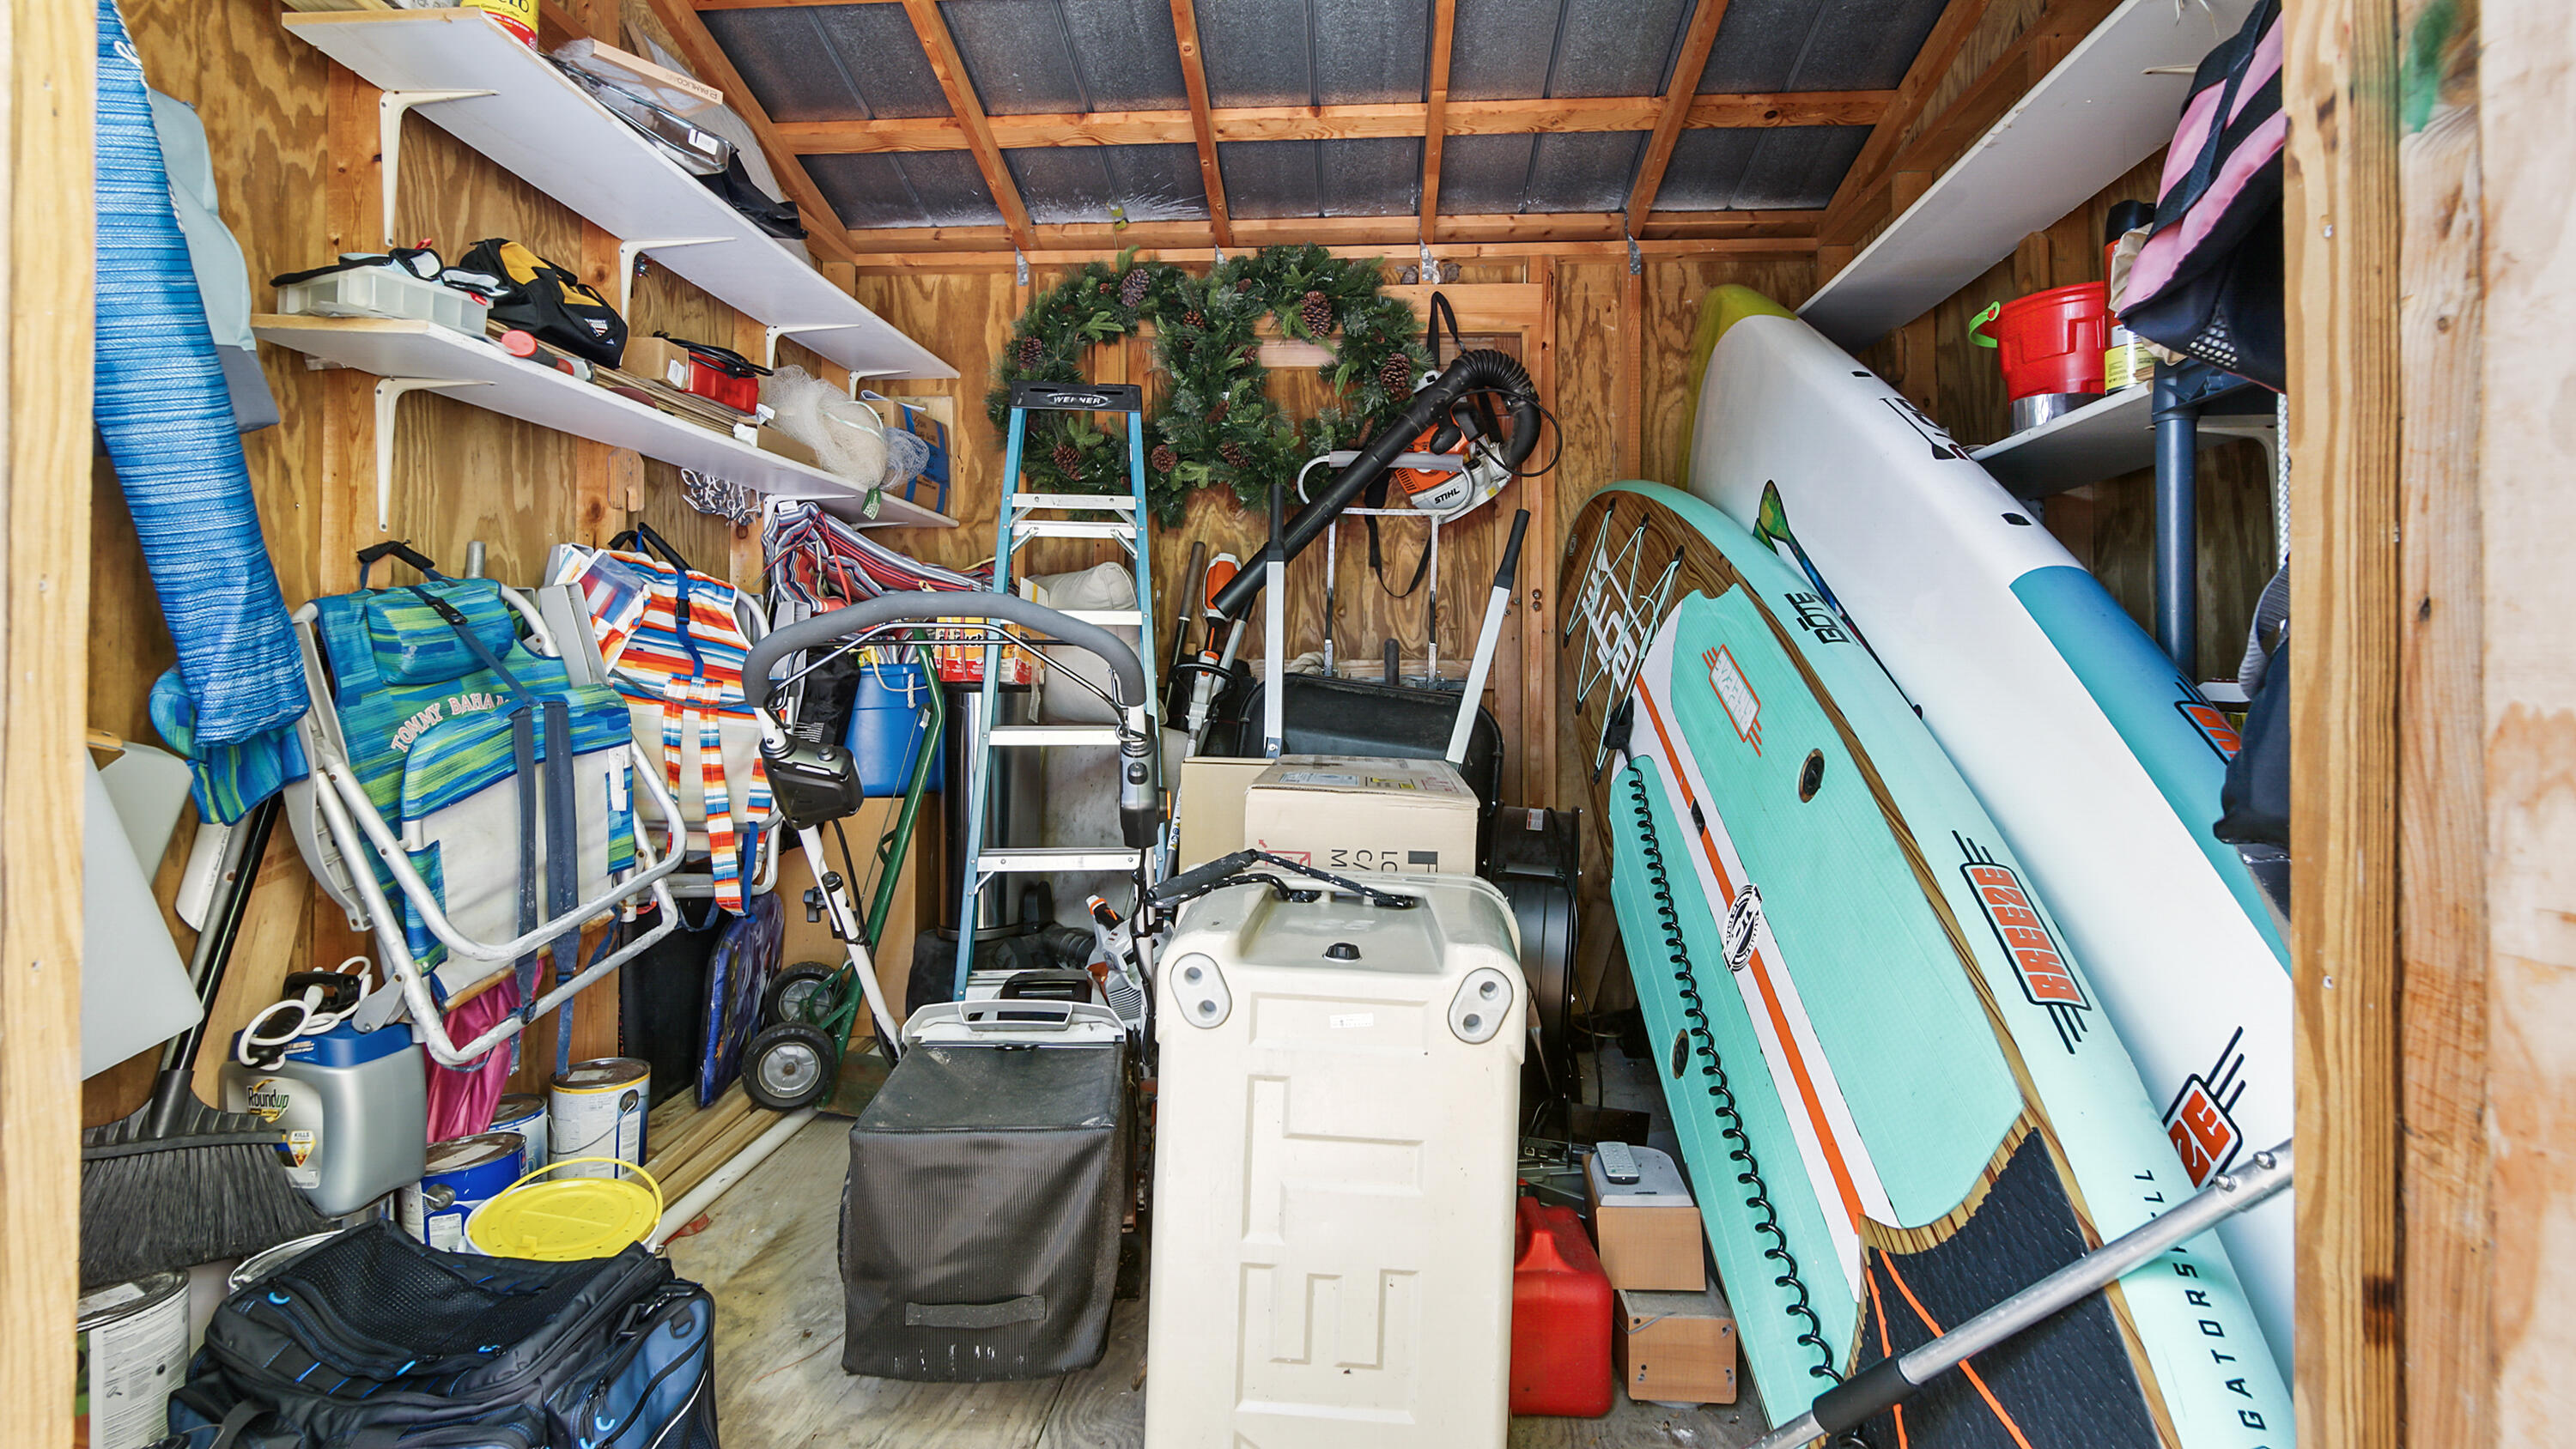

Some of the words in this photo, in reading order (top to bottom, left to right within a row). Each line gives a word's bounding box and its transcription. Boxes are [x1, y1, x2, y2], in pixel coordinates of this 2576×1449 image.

[1434, 488, 1461, 505] STIHL
[391, 702, 444, 753] TOMMY
[1971, 865, 2081, 1003] BREEZE
[247, 1087, 290, 1113] Roundup
[2134, 1167, 2268, 1433] GATORSLL
